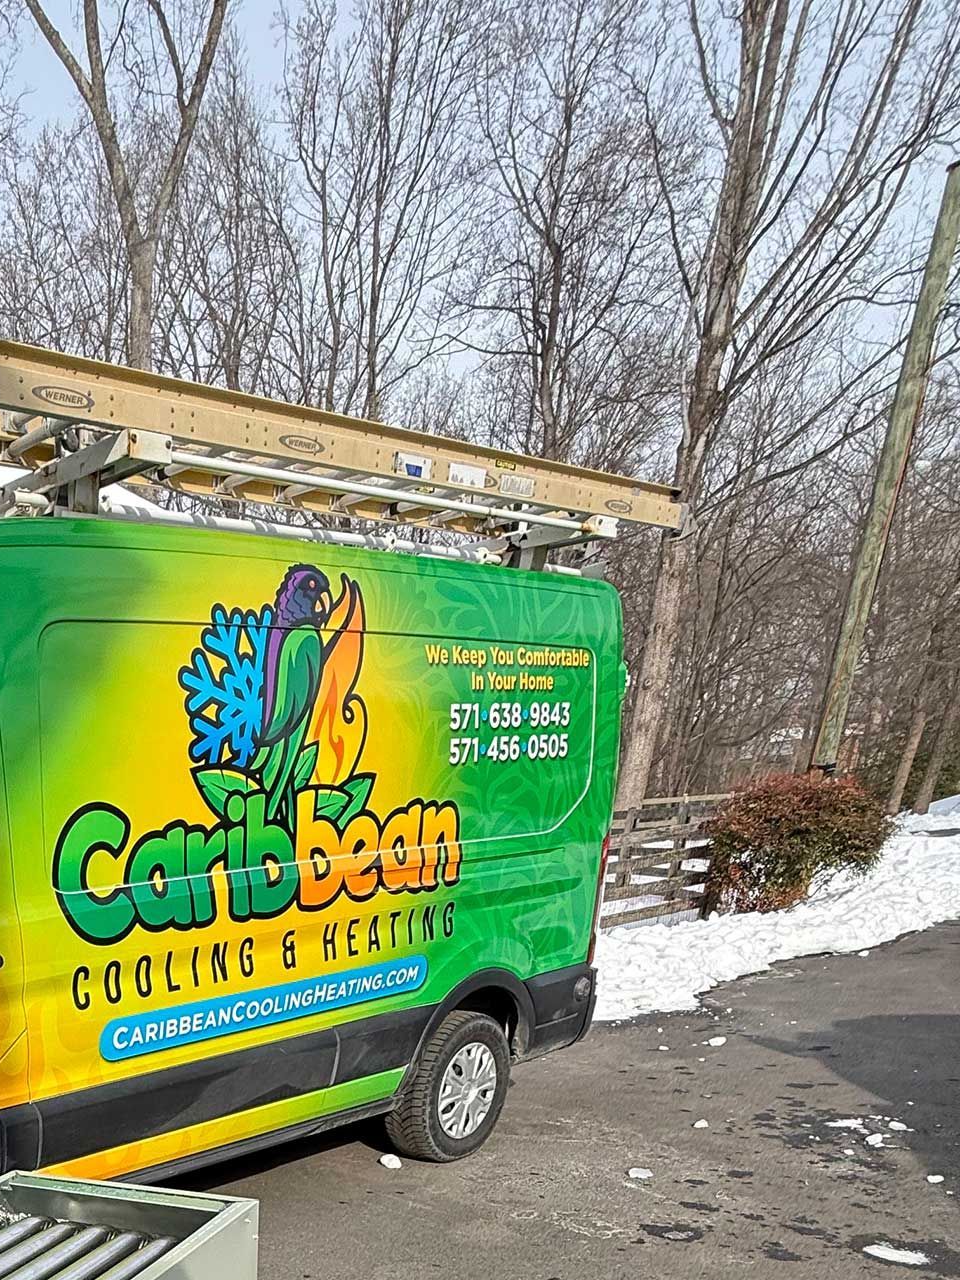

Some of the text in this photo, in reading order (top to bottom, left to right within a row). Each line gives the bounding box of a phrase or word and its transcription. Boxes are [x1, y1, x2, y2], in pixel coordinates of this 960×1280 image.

[44, 388, 84, 405] WERNER
[425, 644, 589, 668] We Keep You Comfortable
[471, 671, 554, 691] In Your Home
[53, 785, 461, 946] Caribbean
[71, 902, 456, 1010] COOLING & HEATING
